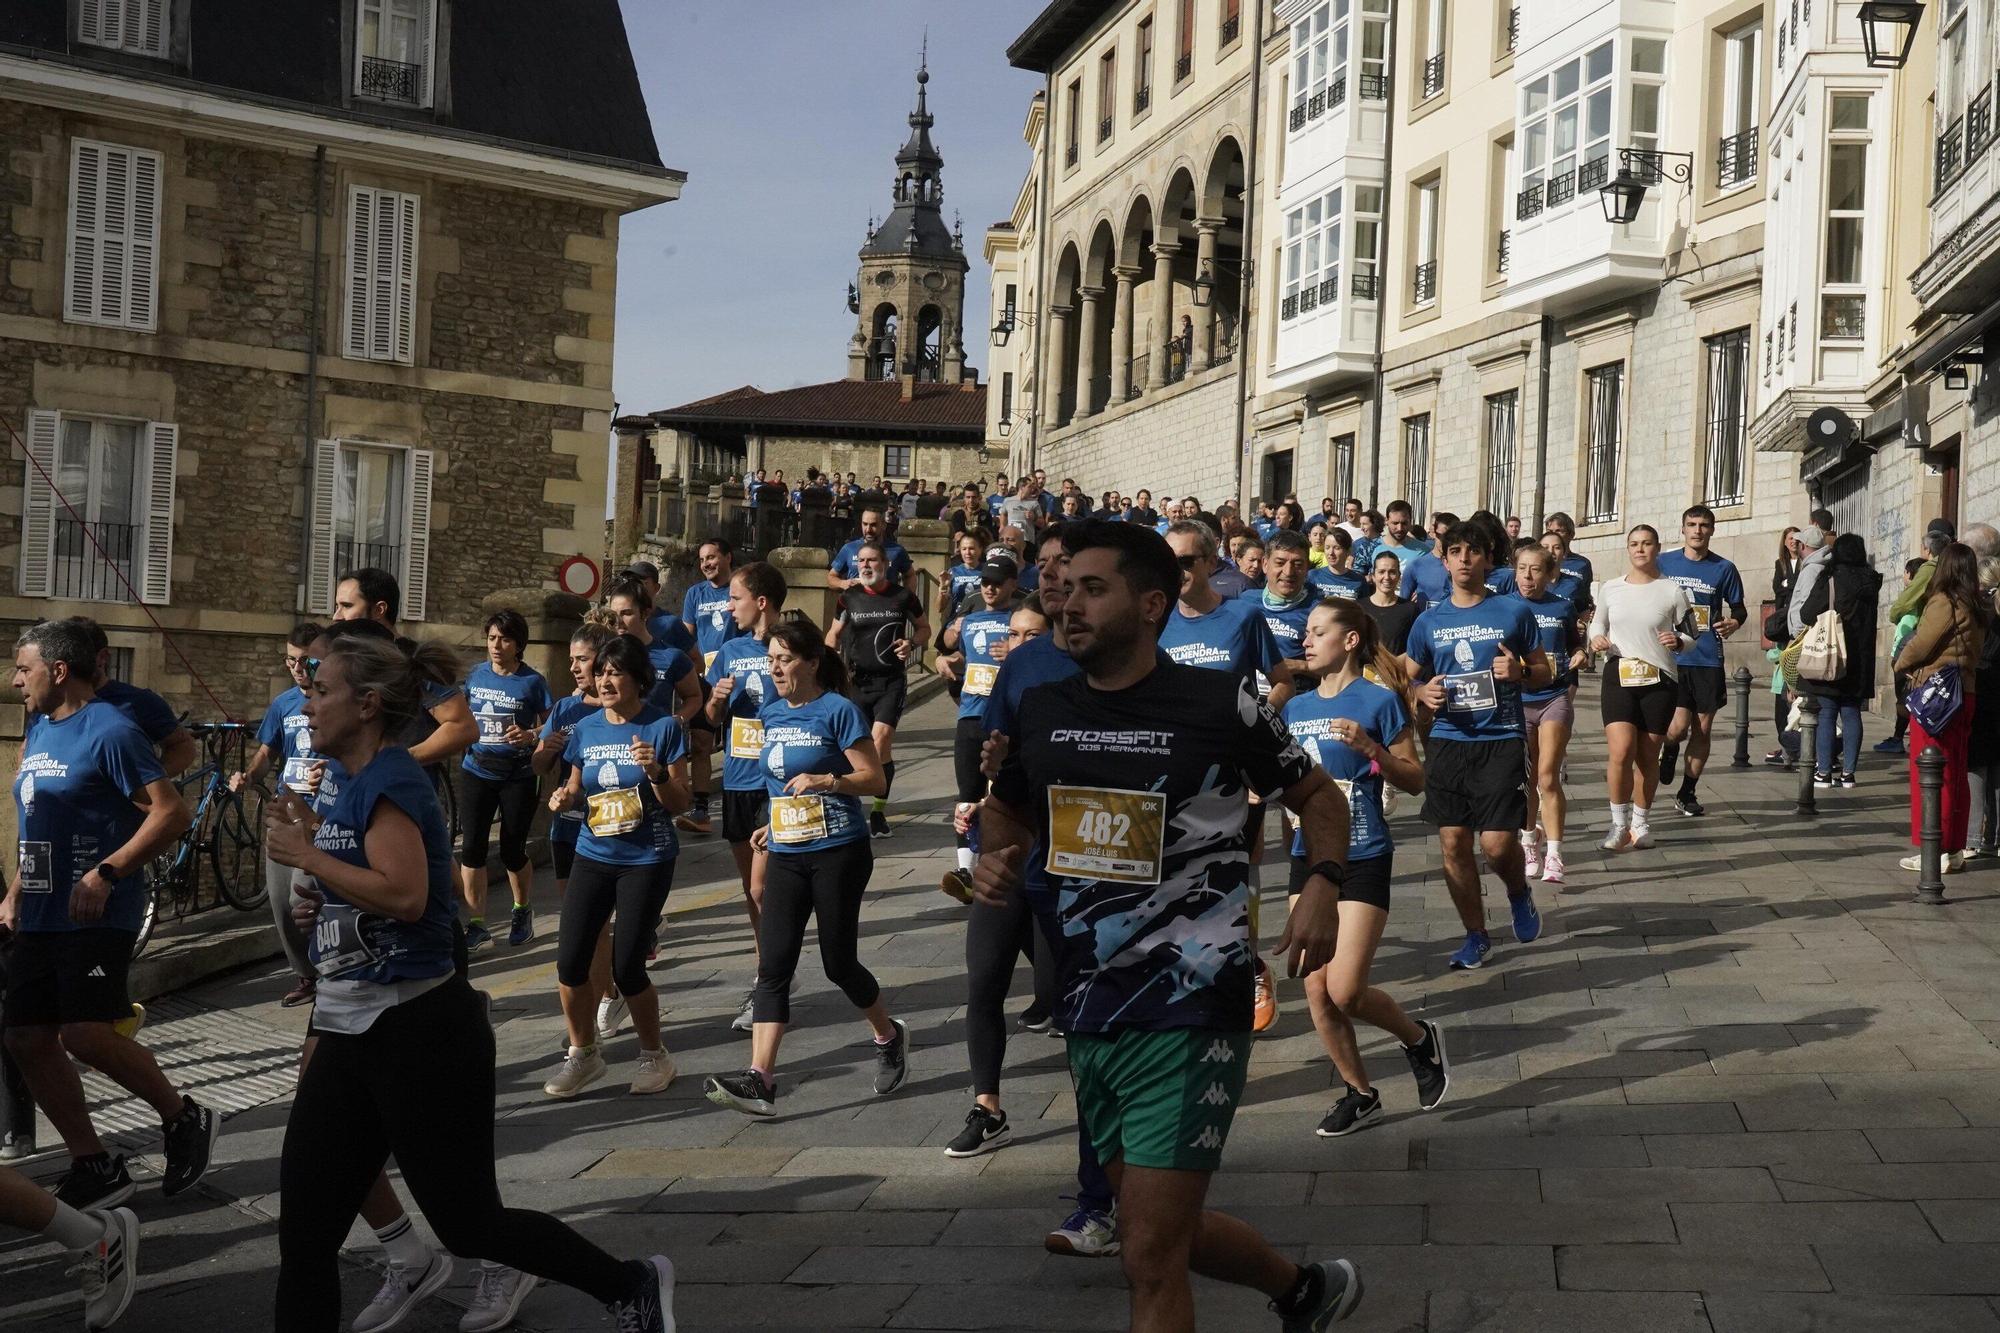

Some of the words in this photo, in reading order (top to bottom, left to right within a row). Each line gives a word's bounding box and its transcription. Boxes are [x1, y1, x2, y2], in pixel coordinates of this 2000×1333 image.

[851, 611, 902, 621] Mercedes-Benz
[1441, 625, 1480, 634] CONQUISTA
[1443, 627, 1494, 640] ALMENDRA
[1470, 634, 1504, 642] KONKISTA
[1170, 643, 1205, 654] CONQUISTA
[1194, 655, 1230, 664] KONKISTA
[483, 721, 502, 733] 758
[1294, 718, 1329, 727] CONQUIST
[742, 728, 765, 743] 226
[1050, 729, 1174, 746] CROSSFIT
[1077, 744, 1101, 752] DOS
[1104, 745, 1171, 755] HERMANAS
[602, 801, 623, 819] 271
[1141, 801, 1158, 811] 10K
[781, 807, 808, 826] 684
[1077, 811, 1130, 847] 482
[1102, 848, 1118, 857] LUIS
[317, 919, 340, 952] 840
